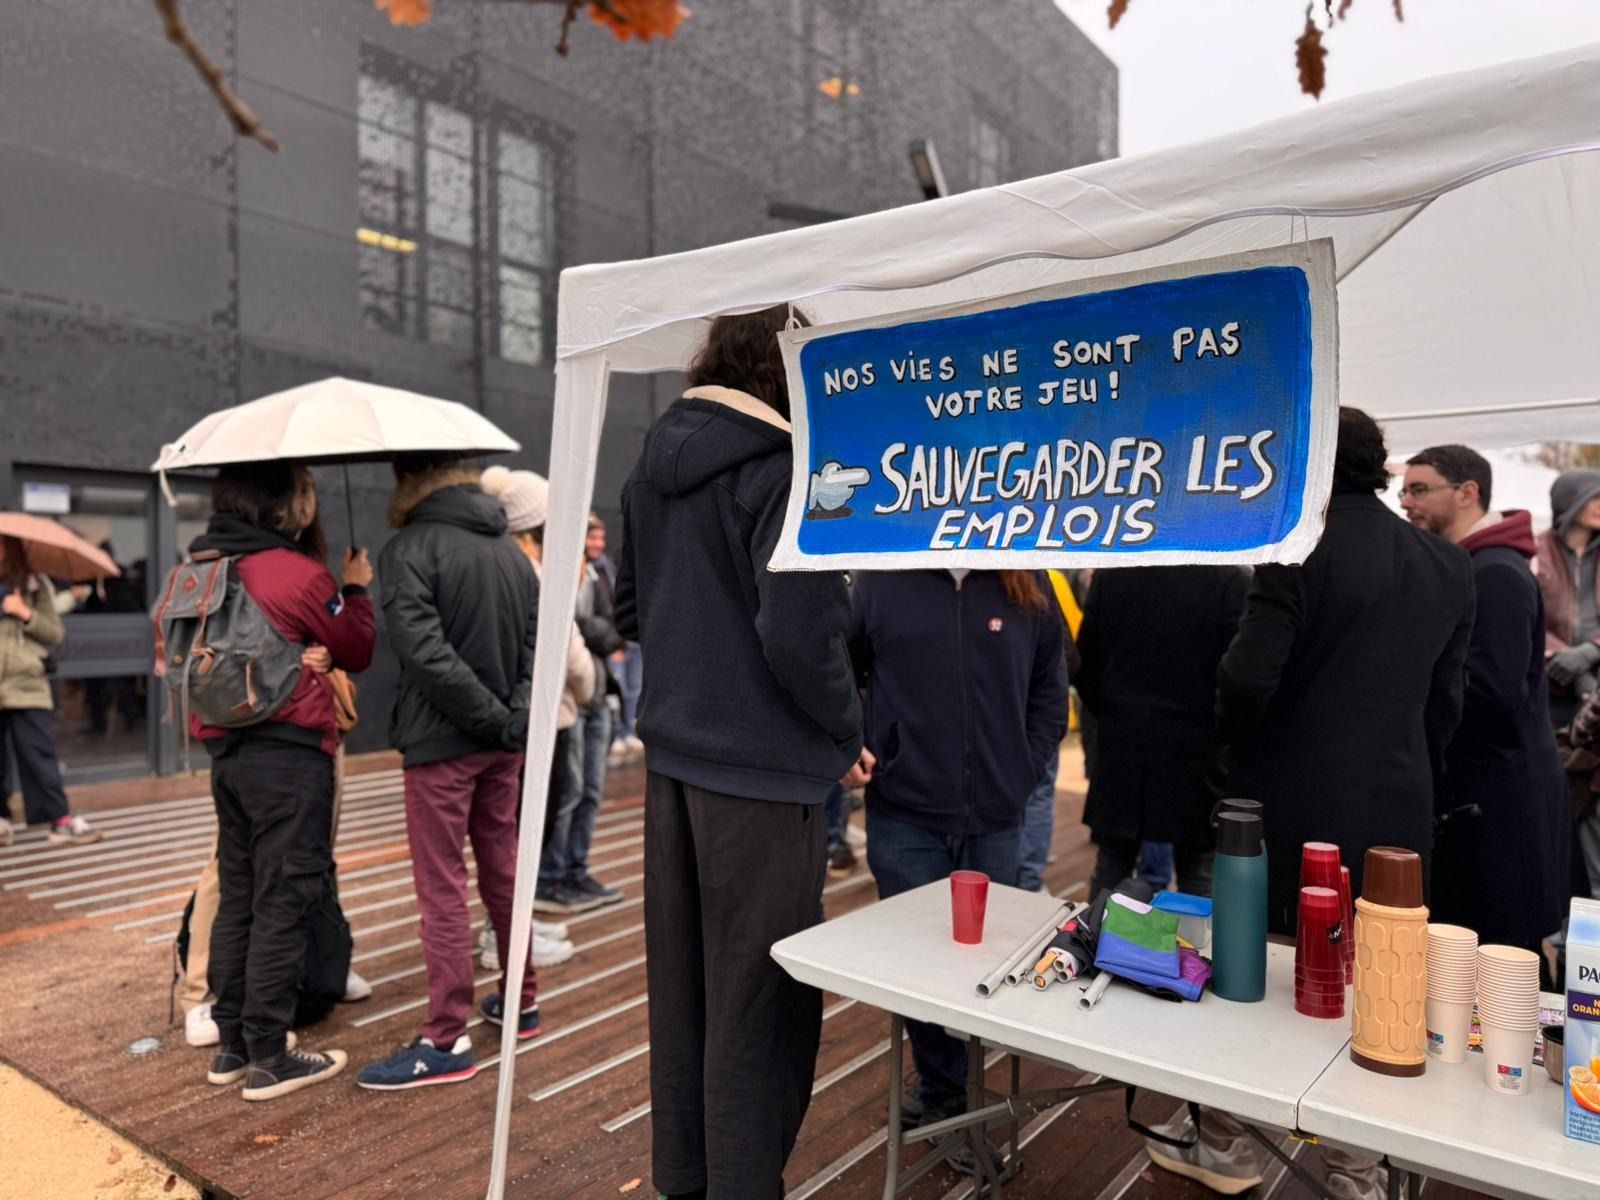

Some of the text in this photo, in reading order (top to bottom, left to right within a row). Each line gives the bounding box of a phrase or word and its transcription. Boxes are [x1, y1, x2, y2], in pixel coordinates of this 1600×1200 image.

[824, 361, 876, 397] NOS
[982, 348, 1020, 378] NE
[1053, 333, 1141, 369] SONT
[1171, 321, 1241, 363] PAS
[925, 385, 1024, 420] VOTRE
[1038, 377, 1099, 406] JEU
[875, 430, 1277, 515] SAUVEGARDER LES
[929, 498, 1158, 550] EMPLOIS
[1578, 965, 1600, 984] PA
